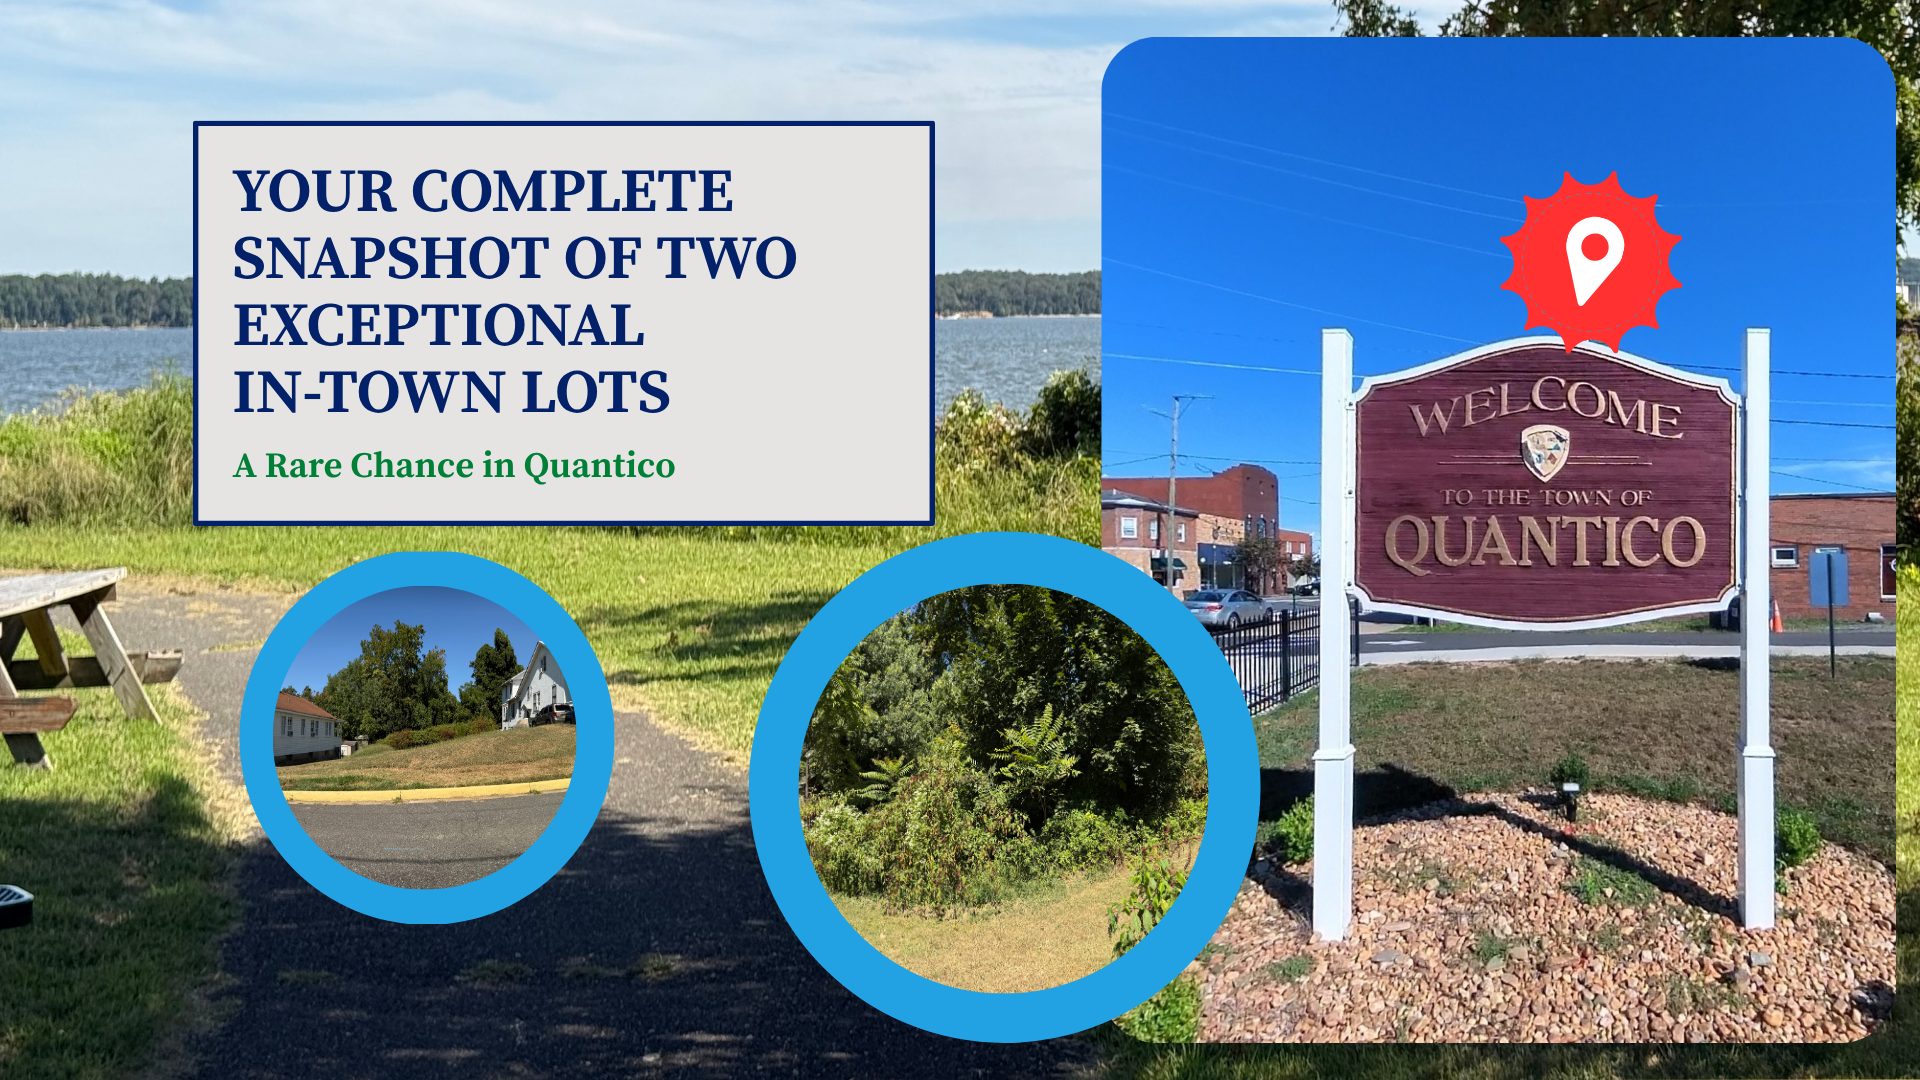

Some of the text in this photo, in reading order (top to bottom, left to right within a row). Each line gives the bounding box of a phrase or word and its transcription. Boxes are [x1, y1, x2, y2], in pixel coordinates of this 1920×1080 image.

[1409, 376, 1684, 439] WELCOME
[1441, 489, 1653, 506] TO THE TOWN OF
[1385, 514, 1706, 577] QUANTICO
